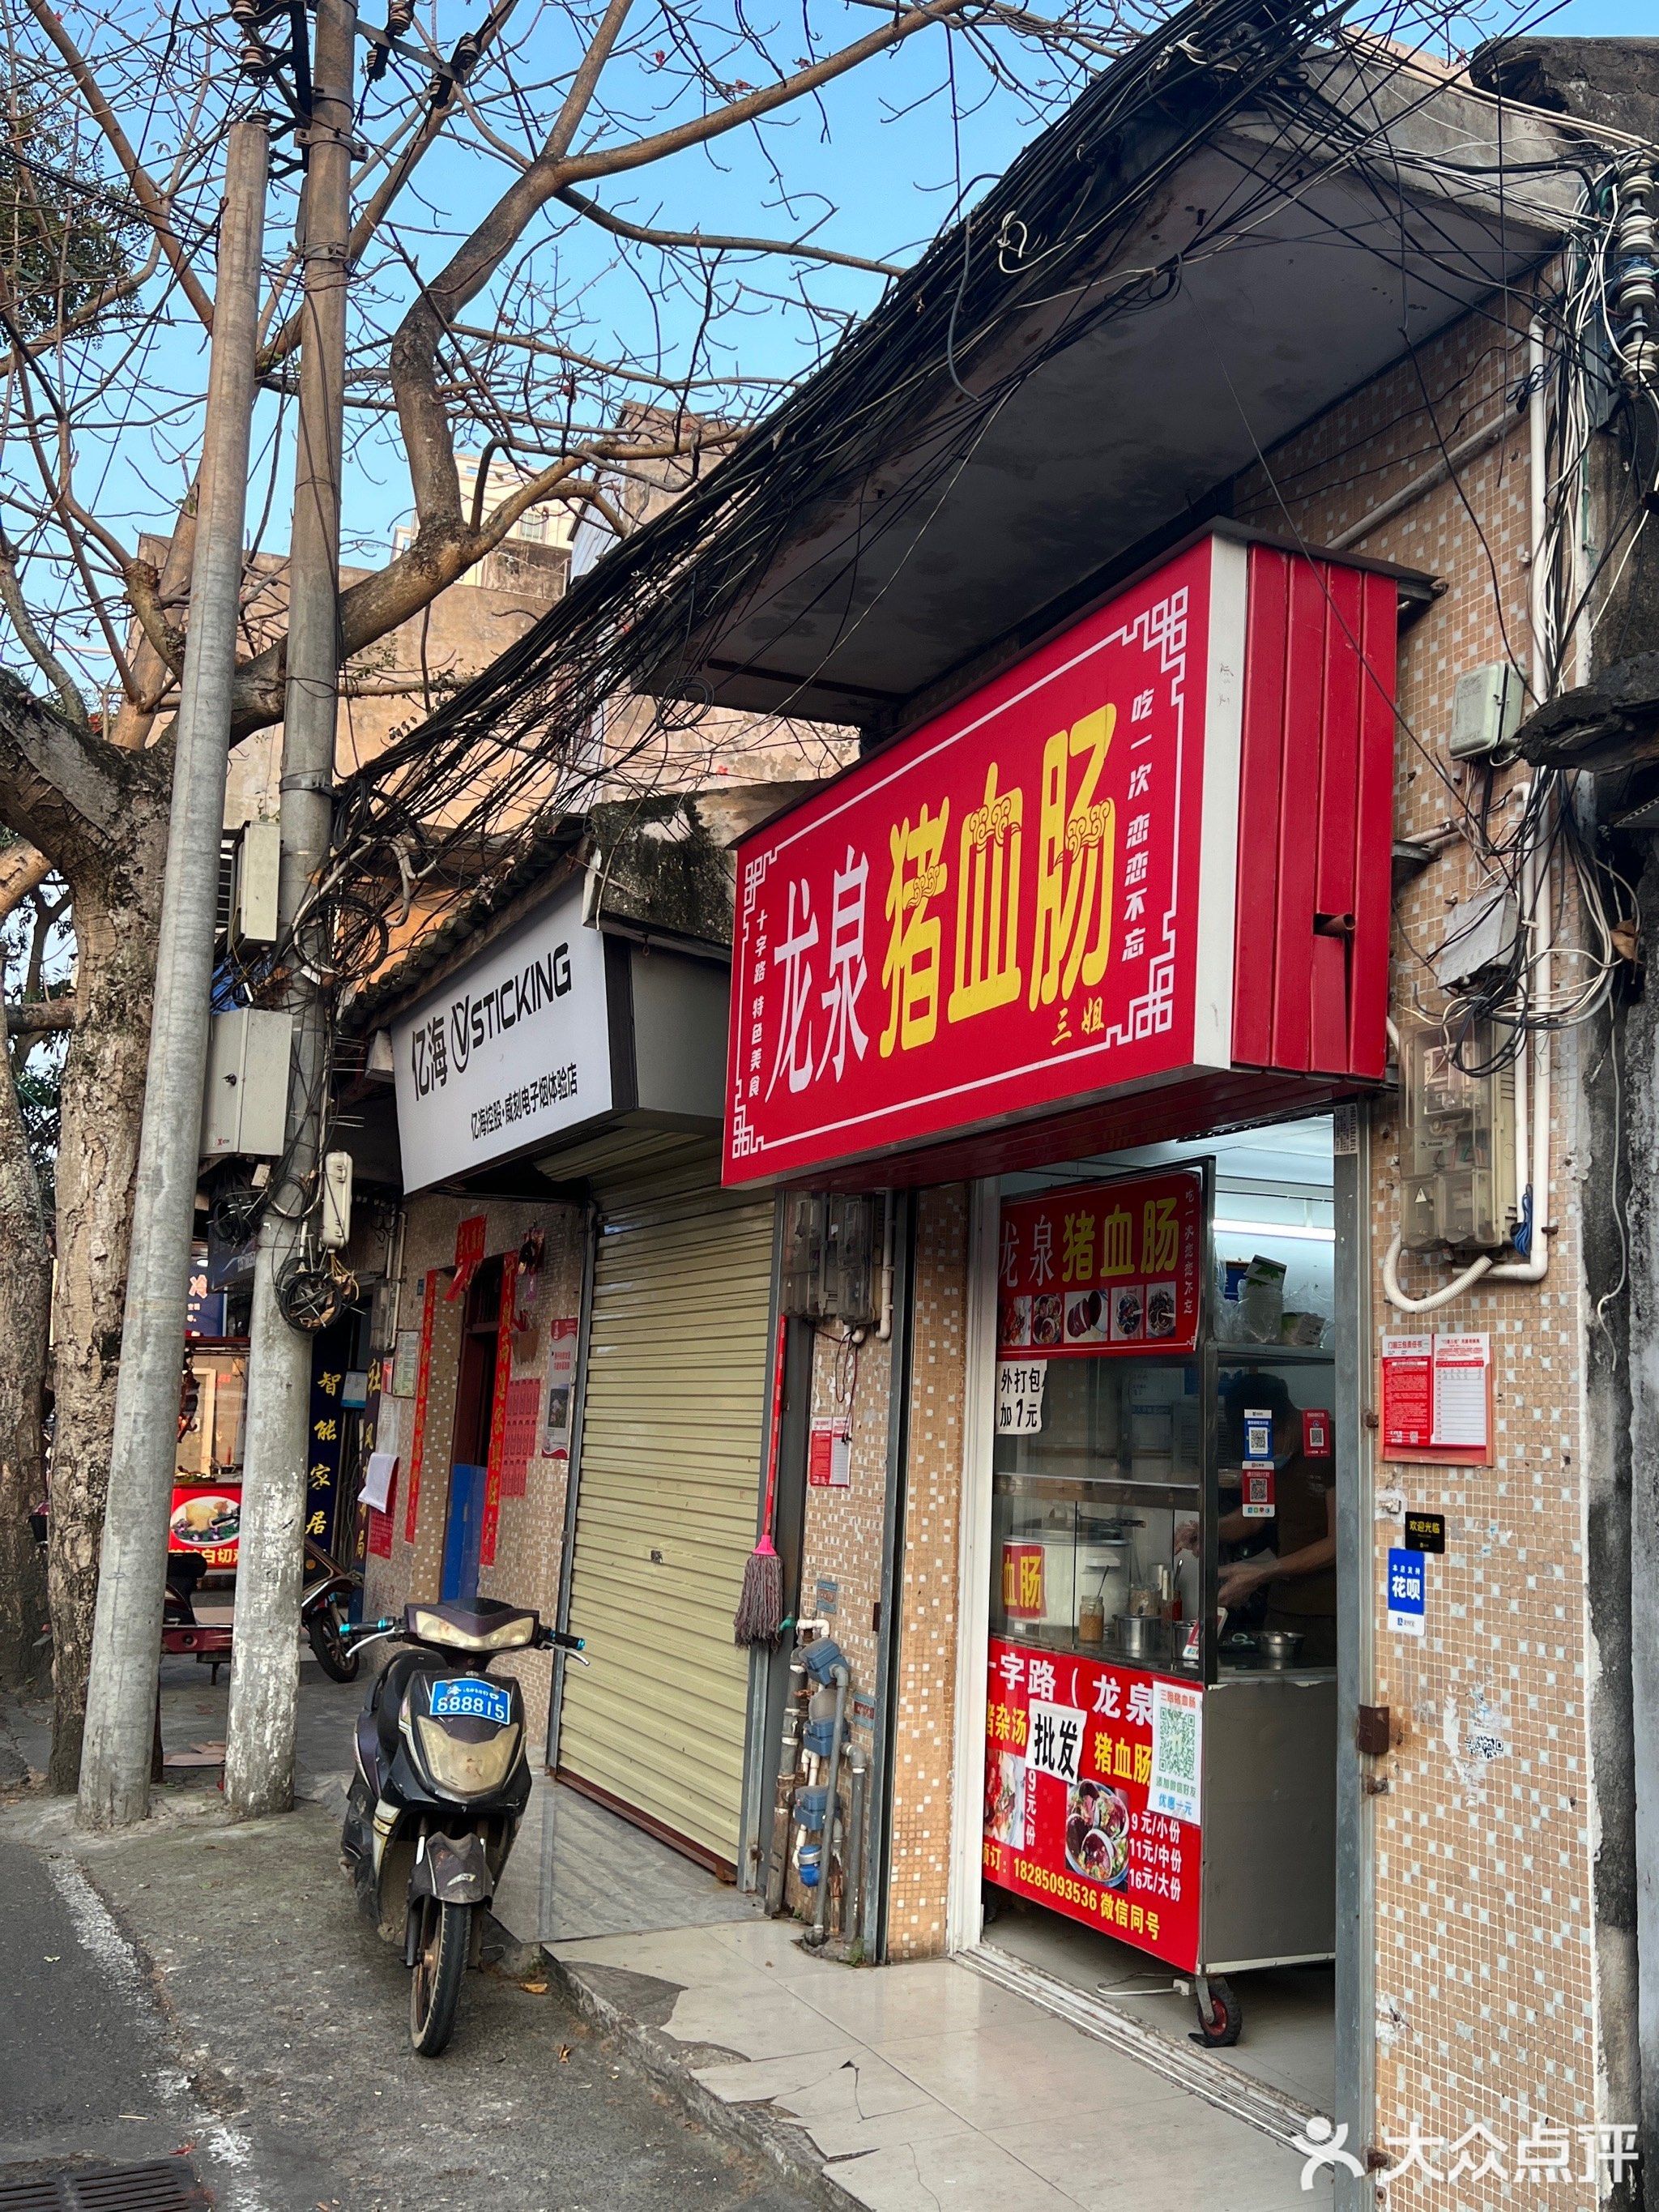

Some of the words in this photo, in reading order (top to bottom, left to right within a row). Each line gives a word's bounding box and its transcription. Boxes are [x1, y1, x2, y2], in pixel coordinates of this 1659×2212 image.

[1121, 687, 1154, 962] 吃一次恋恋不忘
[766, 702, 1117, 1102] 龙泉猪血肠
[753, 910, 767, 984] 十字路
[748, 995, 764, 1097] 特色美食
[1051, 997, 1104, 1045] 三姐
[412, 1015, 448, 1101] 亿海
[998, 1197, 1179, 1287] 龙泉猪血肠
[1000, 1399, 1038, 1428] 加1元
[305, 1371, 342, 1535] 智能家居
[1410, 1520, 1440, 1534] 欢迎光临
[1392, 1576, 1421, 1601] 花呗
[1034, 1713, 1078, 1779] 批发
[1094, 1731, 1153, 1787] 猪血肠
[1025, 1770, 1037, 1847] 9元/份
[1158, 1793, 1192, 1816] 优惠一元
[1129, 1868, 1182, 1902] 16元/大份
[1130, 1838, 1183, 1873] 11元/中份
